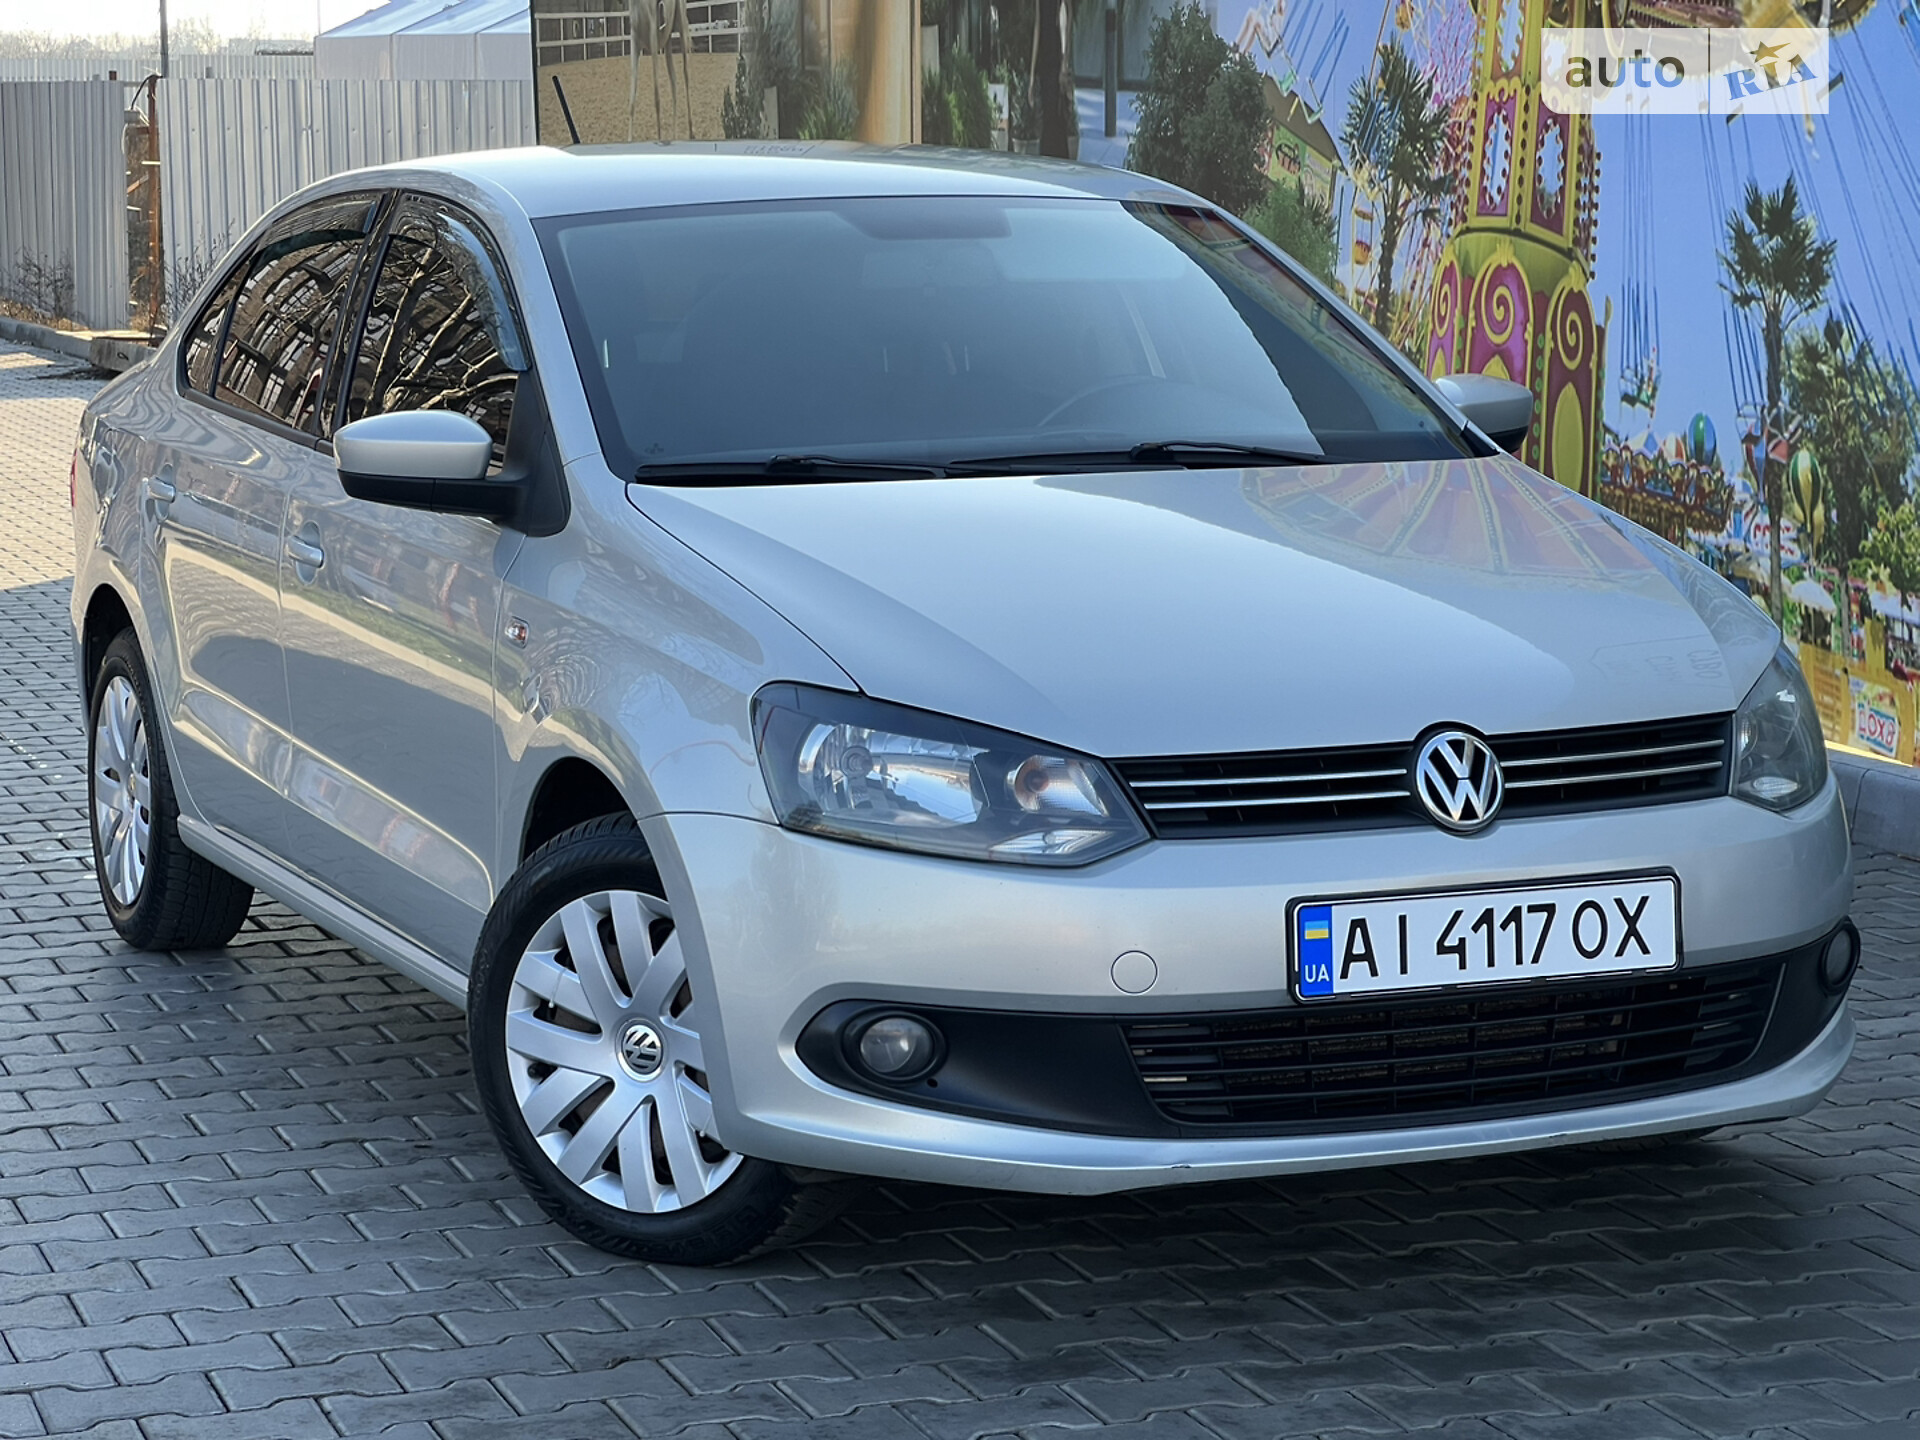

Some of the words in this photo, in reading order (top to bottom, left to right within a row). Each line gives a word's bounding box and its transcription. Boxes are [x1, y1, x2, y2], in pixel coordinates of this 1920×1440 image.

[1339, 914, 1408, 980] AI
[1436, 903, 1557, 971] 4117
[1571, 895, 1651, 960] OX
[1304, 963, 1330, 984] UA
